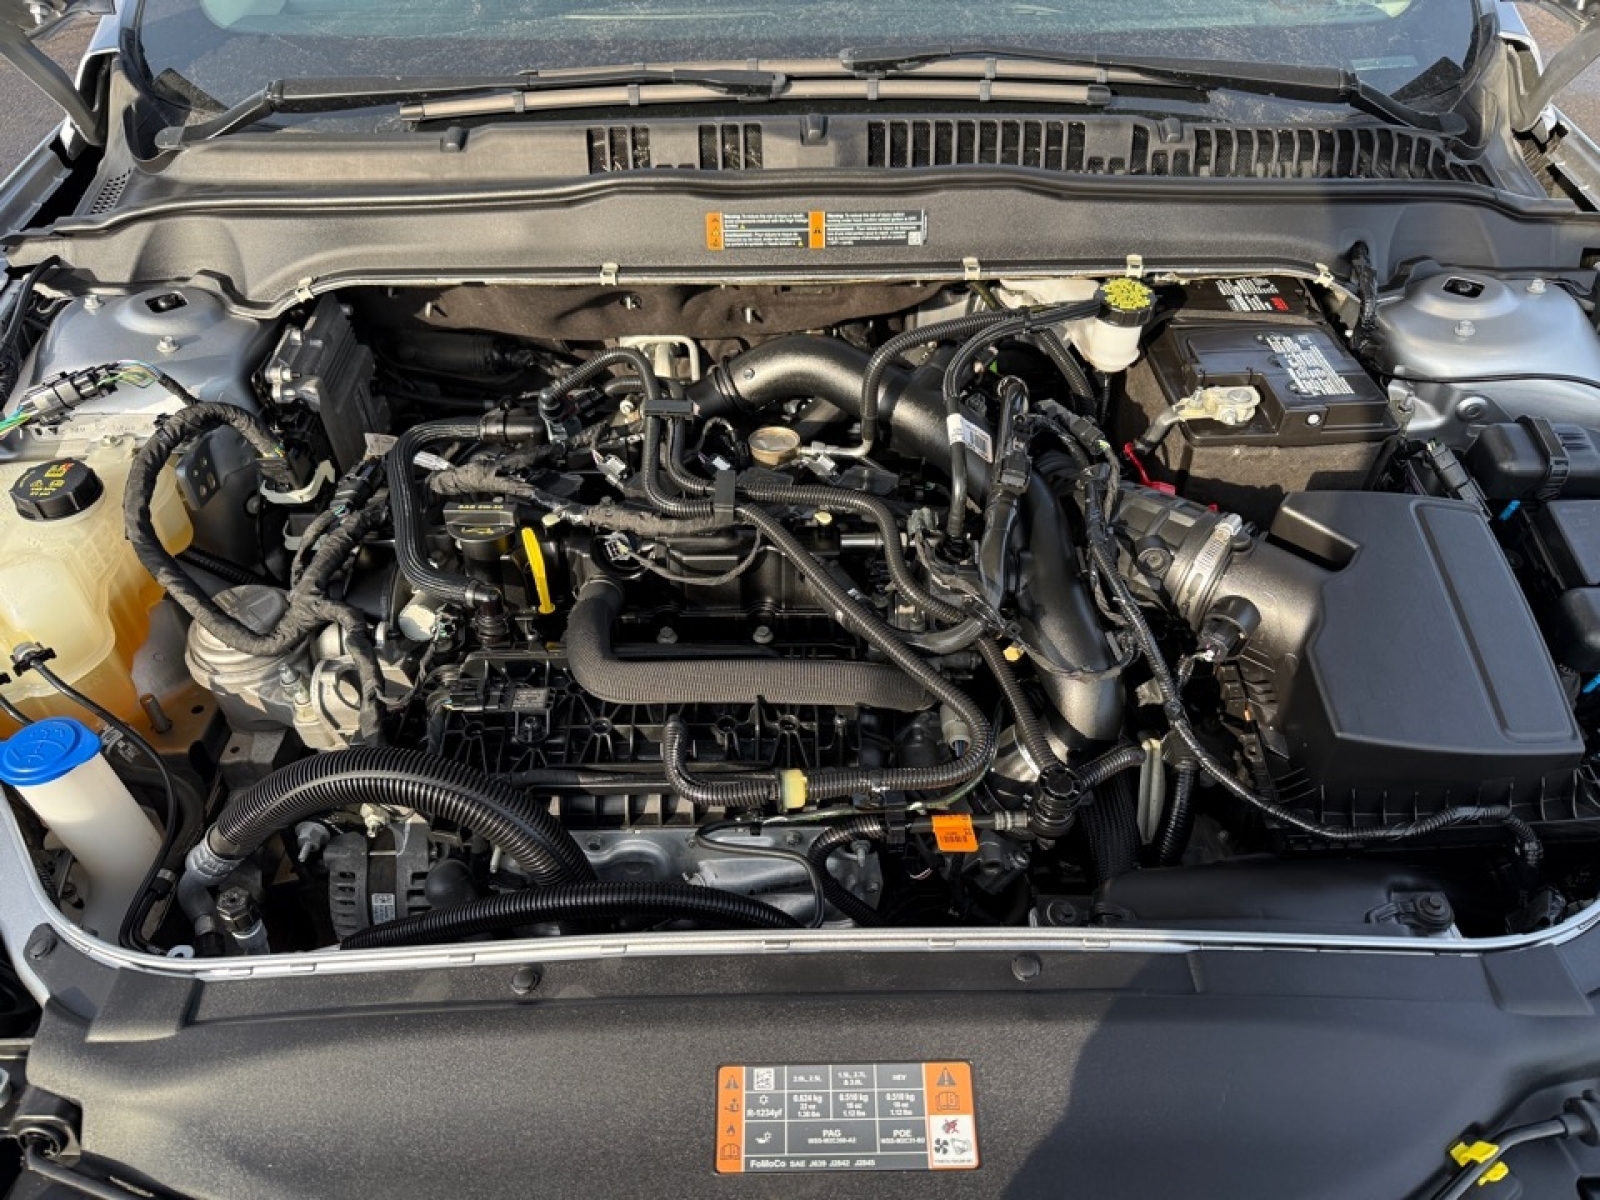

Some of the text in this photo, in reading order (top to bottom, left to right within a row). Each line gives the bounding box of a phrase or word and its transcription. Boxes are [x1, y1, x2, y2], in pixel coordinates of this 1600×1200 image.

[813, 1094, 822, 1103] kg
[860, 1093, 869, 1103] kg
[905, 1093, 915, 1102] kg
[746, 1108, 782, 1118] R-1234yf
[822, 1129, 842, 1137] PAG
[893, 1129, 912, 1137] POE
[750, 1159, 786, 1168] FoMoCo
[790, 1159, 805, 1167] SAE
